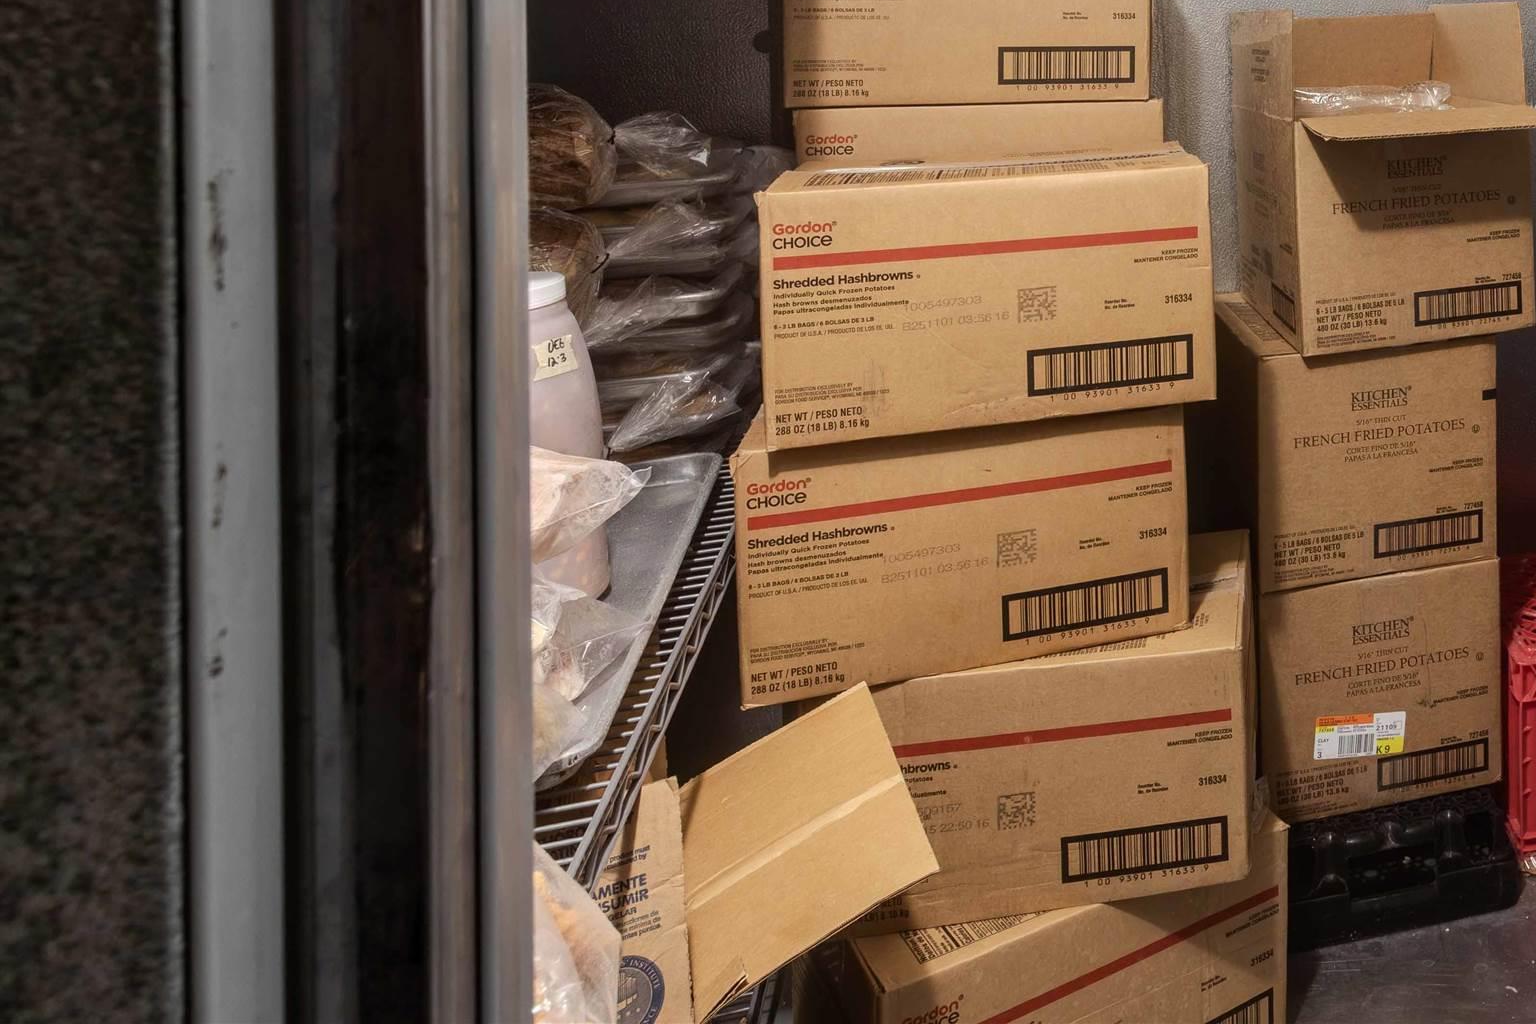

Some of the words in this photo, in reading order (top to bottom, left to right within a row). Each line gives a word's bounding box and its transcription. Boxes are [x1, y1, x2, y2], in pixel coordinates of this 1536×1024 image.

[806, 134, 854, 144] Gordon
[1333, 199, 1388, 214] FRENCH
[1392, 195, 1430, 210] FRIED
[1434, 190, 1500, 205] POTATOES
[773, 222, 832, 235] Gordon
[774, 276, 834, 289] Shredded
[838, 272, 913, 284] Hashbrowns
[774, 291, 814, 299] Individually
[821, 296, 872, 304] desmenuzados
[1165, 293, 1192, 304] 316334
[1347, 311, 1363, 320] PESO
[1365, 310, 1381, 318] NETO
[1085, 389, 1119, 398] 93901
[1128, 384, 1160, 394] 31633
[1351, 387, 1408, 403] KITCHEN
[1352, 398, 1408, 411] ESSENTIALS
[776, 414, 792, 423] NET
[794, 412, 808, 421] WT
[816, 409, 837, 419] PESO
[841, 406, 862, 416] NETO
[776, 427, 790, 435] 288
[794, 425, 804, 434] OZ
[808, 423, 820, 433] (18
[824, 421, 837, 431] LB)
[840, 420, 858, 429] 8.16
[860, 418, 869, 427] kg
[1295, 432, 1350, 448] FRENCH
[1355, 427, 1394, 441] FRIED
[1398, 419, 1465, 437] POTATOES
[747, 480, 806, 495] Gordon
[748, 532, 808, 549] Shredded
[813, 524, 888, 541] Hashbrowns
[1140, 528, 1167, 539] 316334
[748, 550, 788, 559] Individually
[839, 539, 869, 547] Potatoes
[795, 551, 846, 561] desmenuzados
[1061, 628, 1094, 639] 93901
[1104, 621, 1136, 632] 31633
[1352, 618, 1409, 636] KITCHEN
[1353, 629, 1410, 645] ESSENTIALS
[752, 673, 767, 682] NET
[770, 671, 783, 680] WT
[791, 665, 812, 676] PESO
[816, 662, 837, 672] NETO
[1296, 667, 1351, 685] FRENCH
[1357, 660, 1395, 675] FRIED
[1400, 647, 1470, 668] POTATOES
[752, 686, 766, 695] 288
[770, 683, 780, 692] OZ
[783, 680, 796, 691] (18
[799, 677, 812, 687] LB)
[815, 675, 833, 684] 8.16
[836, 674, 844, 682] kg
[599, 889, 648, 913] SUMIR
